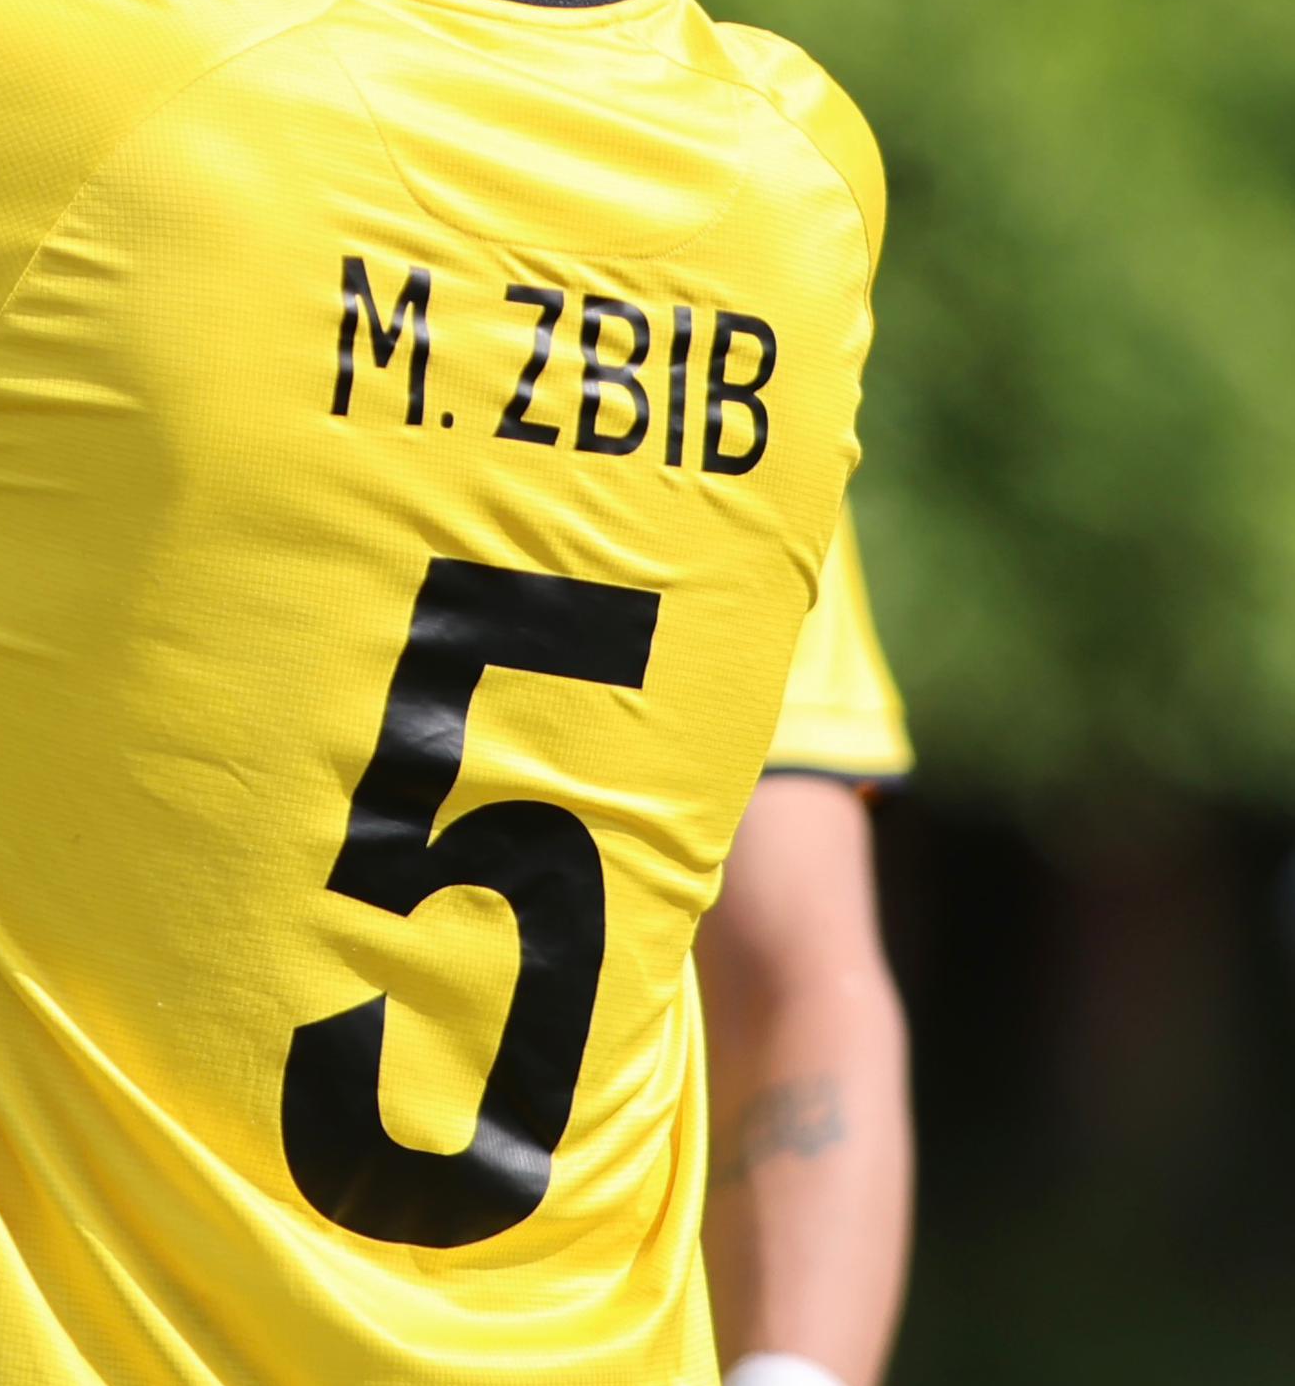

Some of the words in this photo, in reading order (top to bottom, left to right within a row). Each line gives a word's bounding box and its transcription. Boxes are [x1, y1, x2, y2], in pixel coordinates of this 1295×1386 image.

[330, 254, 455, 429] M.
[494, 283, 778, 477] ZBIB
[279, 556, 662, 1249] 5
